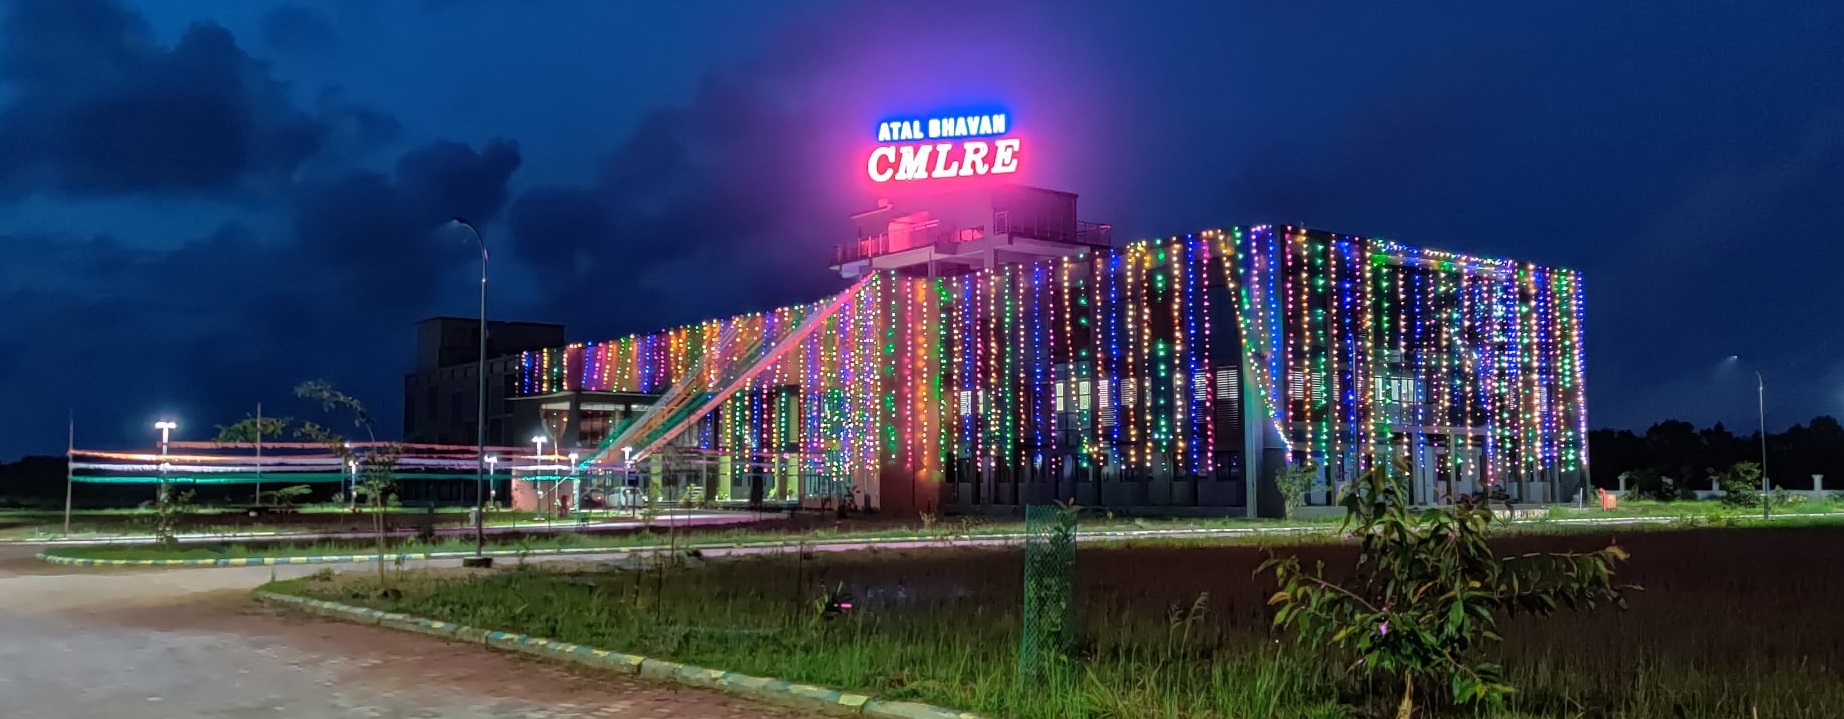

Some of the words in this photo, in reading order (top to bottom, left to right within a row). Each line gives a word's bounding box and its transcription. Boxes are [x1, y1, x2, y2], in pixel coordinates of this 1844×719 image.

[878, 120, 924, 141] ATAL
[928, 113, 1006, 138] BHAVAN
[867, 138, 1021, 183] CMLRE
